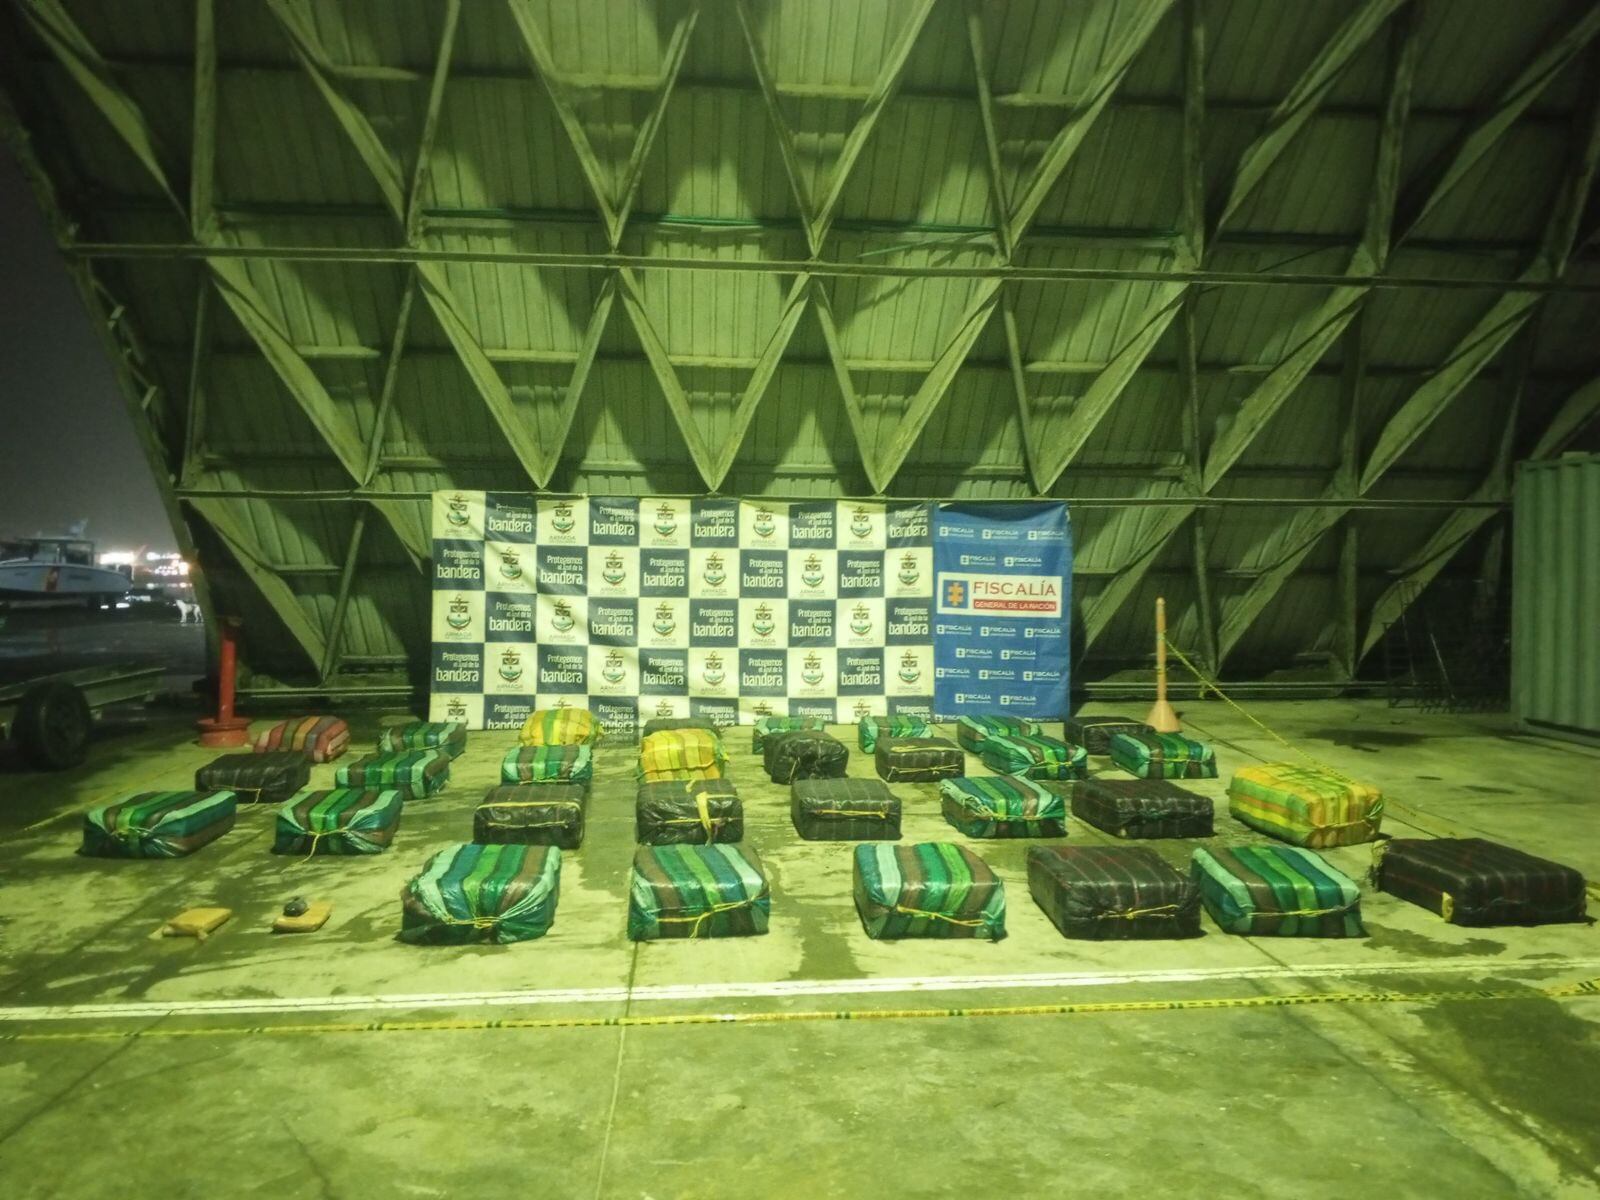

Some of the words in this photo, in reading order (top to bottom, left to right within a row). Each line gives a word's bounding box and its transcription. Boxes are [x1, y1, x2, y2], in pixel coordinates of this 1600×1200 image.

[489, 517, 532, 532] bandera
[594, 520, 635, 535] bandera
[695, 523, 735, 537] bandera
[890, 523, 928, 538] bandera
[793, 525, 832, 539] bandera
[437, 564, 480, 578] bandera
[541, 569, 583, 584] bandera
[644, 572, 685, 586] bandera
[744, 573, 783, 587] bandera
[842, 574, 880, 588] bandera
[973, 581, 1056, 596] FISCALÍA
[490, 616, 532, 631] bandera
[592, 621, 633, 635] bandera
[694, 622, 734, 636] bandera
[793, 623, 832, 637] bandera
[889, 621, 928, 635] bandera
[436, 667, 479, 681] bandera
[542, 668, 583, 683] bandera
[644, 671, 684, 685] bandera
[743, 672, 783, 686] bandera
[842, 671, 880, 686] bandera
